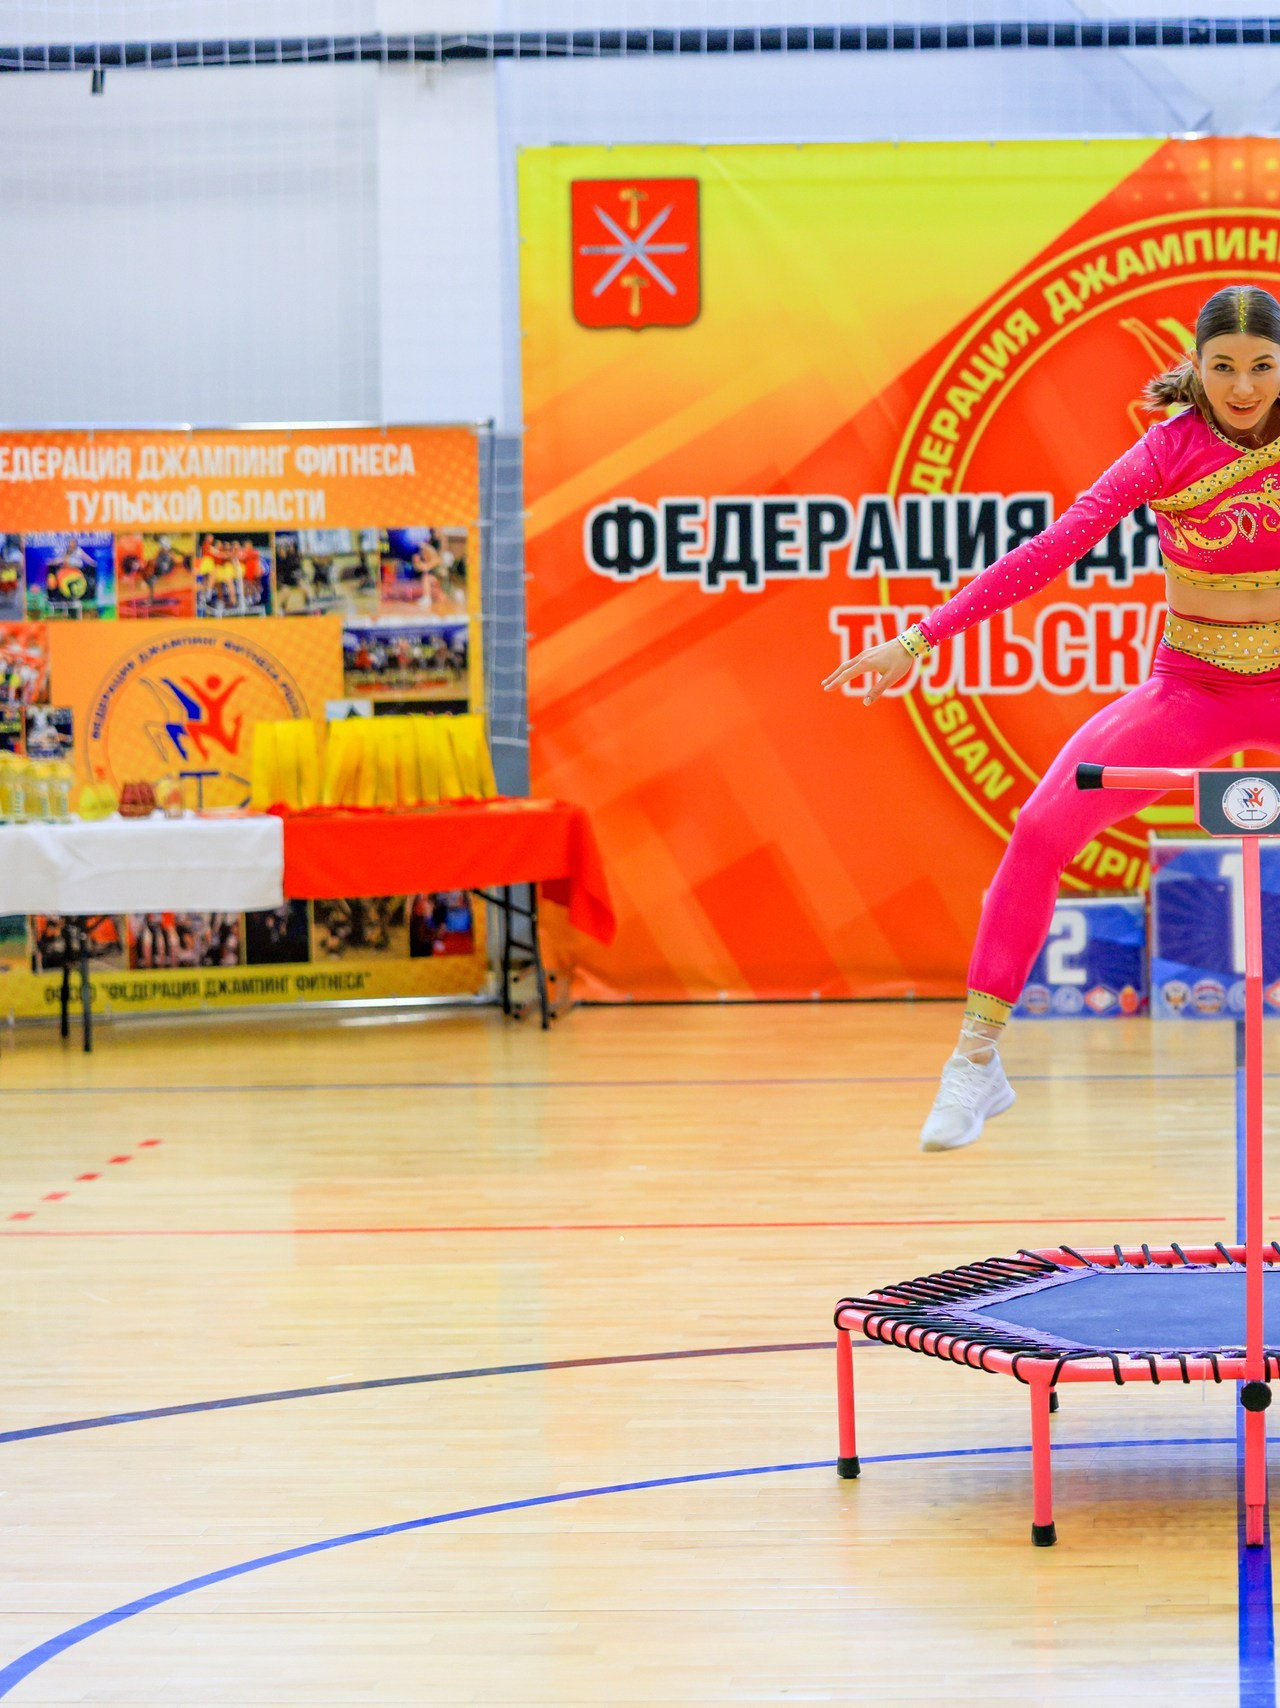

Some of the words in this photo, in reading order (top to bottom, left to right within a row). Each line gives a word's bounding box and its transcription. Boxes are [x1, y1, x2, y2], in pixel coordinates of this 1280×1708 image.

[910, 308, 1041, 495] ДЕРАЦИЯ
[0, 446, 132, 483] ЕДЕРАЦИЯ
[137, 444, 290, 482] ДЖАМПИНГ
[295, 443, 416, 477] ФИТНЕСА
[66, 486, 203, 525] ТУЛЬСКОЙ
[207, 489, 326, 523] ОБЛАСТИ
[587, 492, 1051, 588] ФЕДЕРАЦИЯ
[1046, 910, 1087, 985] 2
